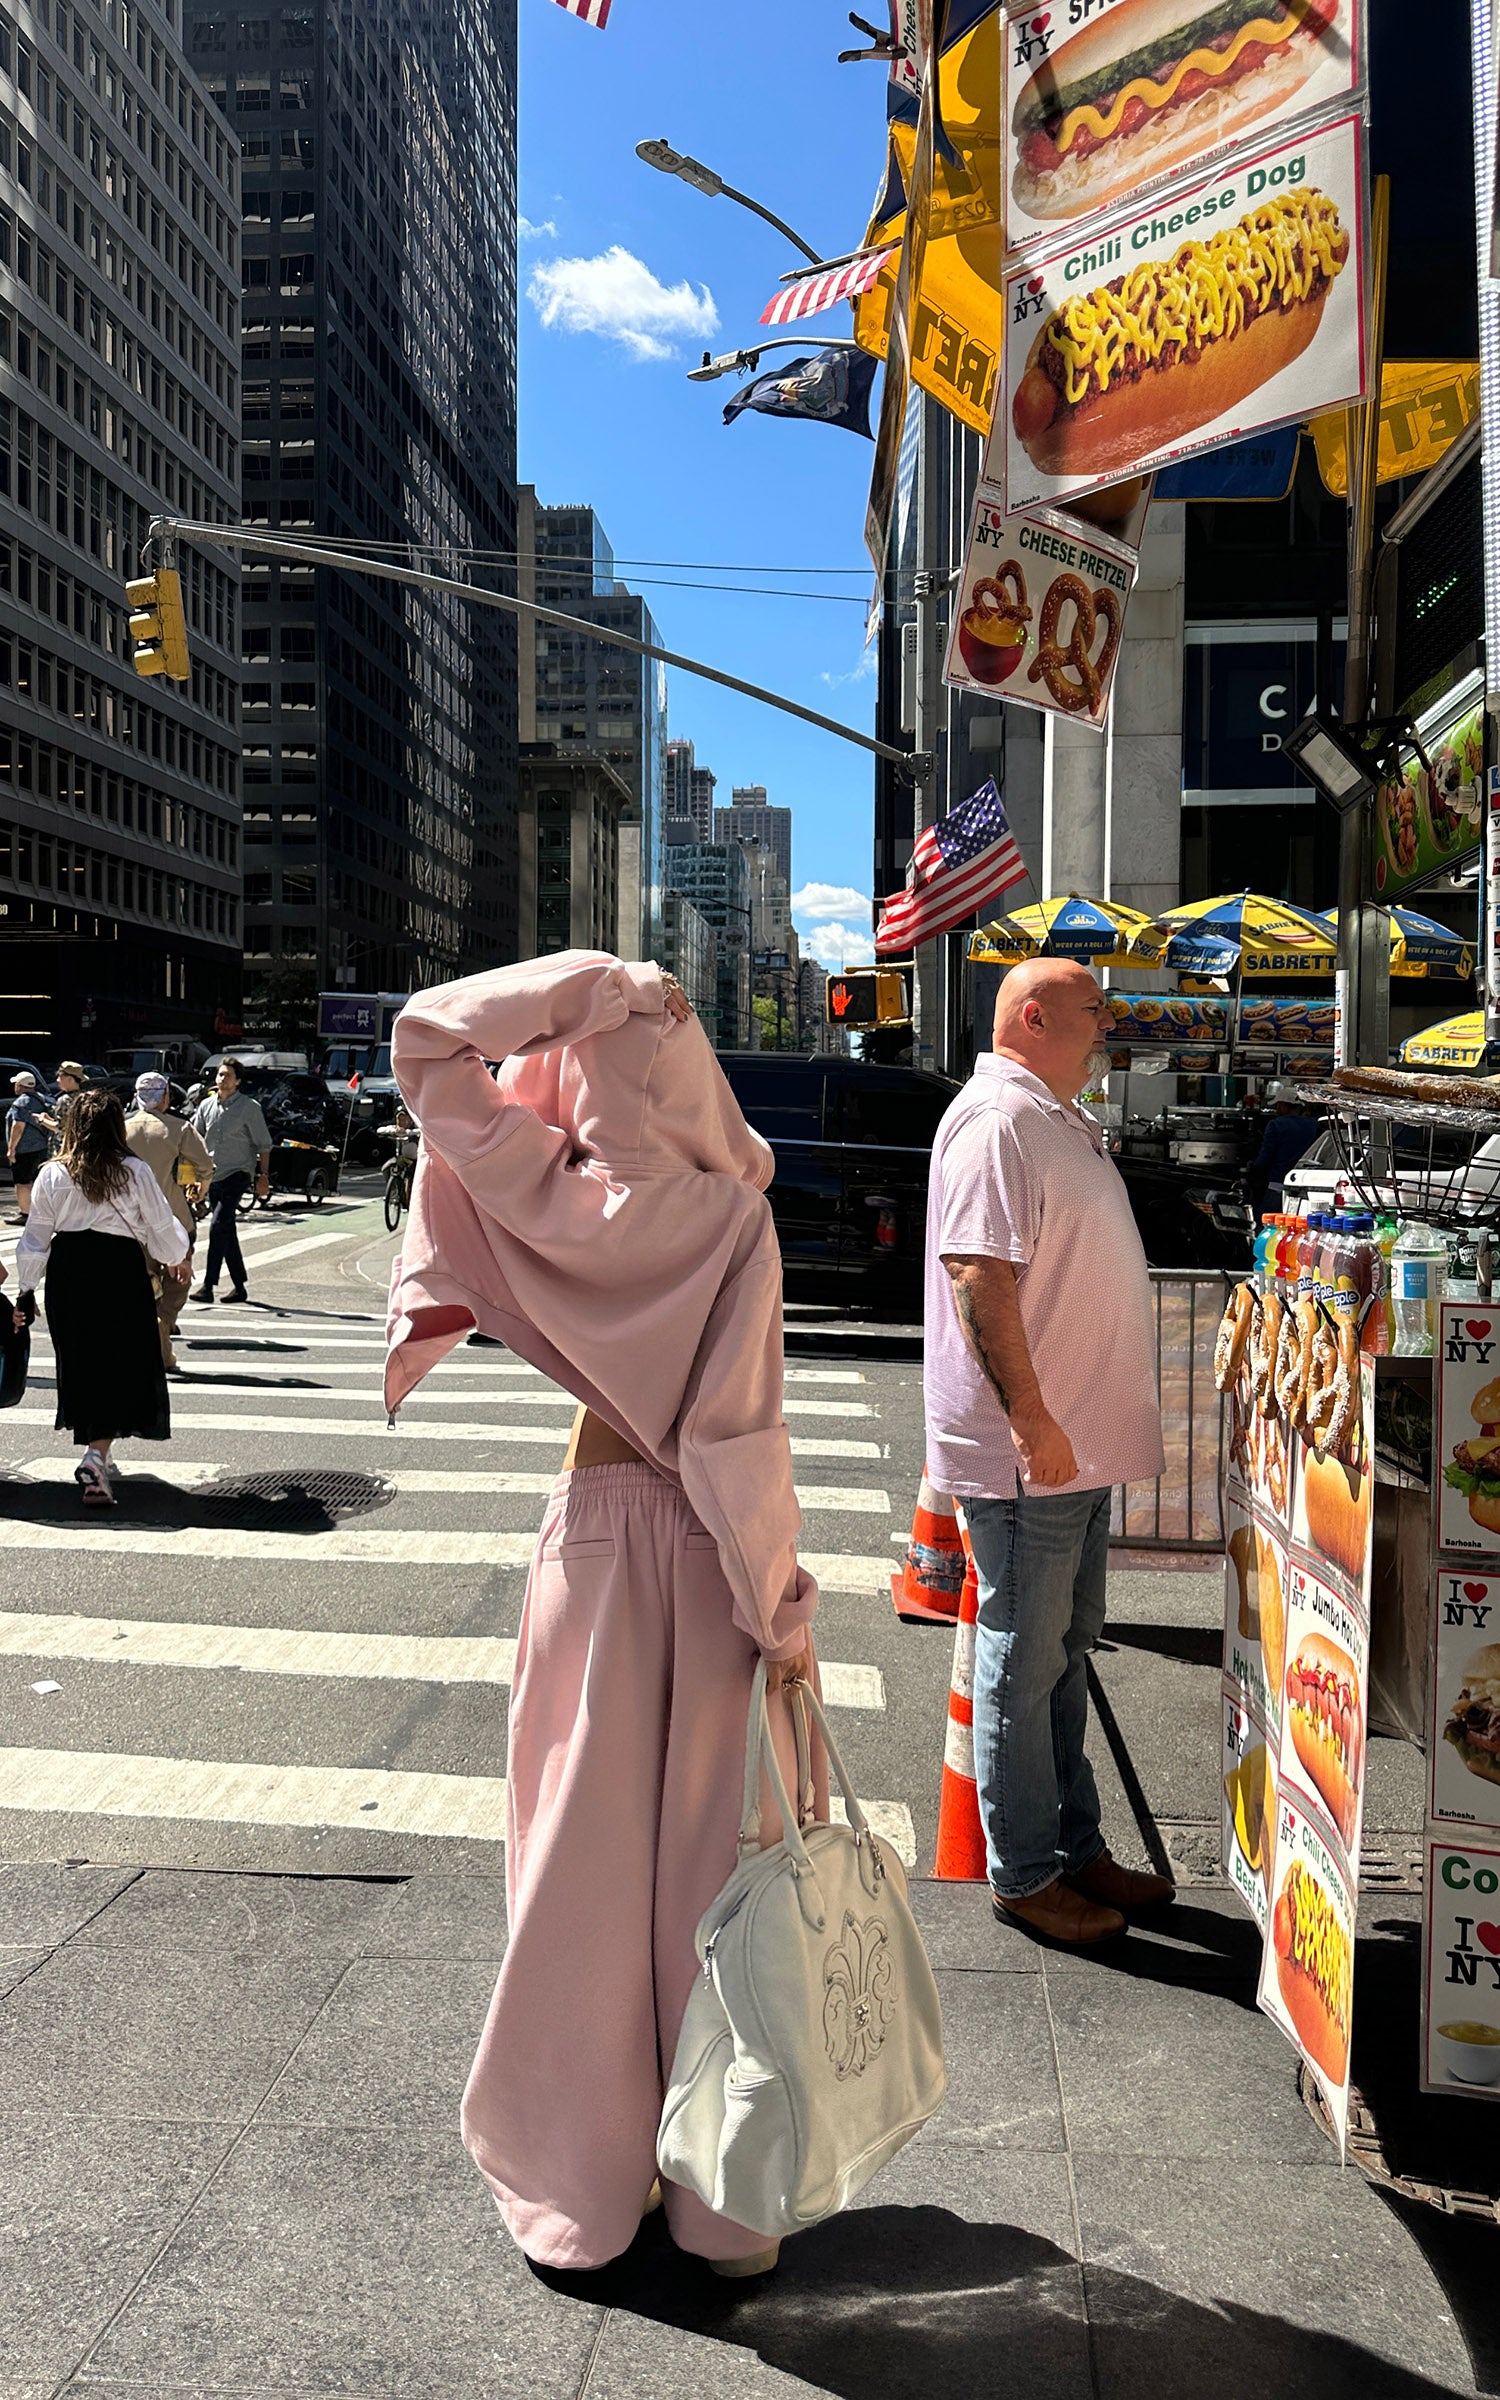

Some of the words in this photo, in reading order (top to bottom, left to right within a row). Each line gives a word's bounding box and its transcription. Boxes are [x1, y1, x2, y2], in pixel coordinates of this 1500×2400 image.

[1014, 29, 1055, 67] NY
[1063, 236, 1121, 282] Chili
[1131, 188, 1236, 250] Cheese
[1247, 154, 1307, 197] Dog
[1013, 291, 1048, 324] NY
[1135, 452, 1171, 470] PRINTING
[975, 524, 1004, 549] NY
[1018, 526, 1077, 567] CHEESE
[1079, 550, 1128, 591] PRETZEL
[1249, 921, 1303, 936] SABRETT
[978, 937, 1043, 952] SABRETT
[1246, 954, 1337, 970] SABRETT
[1409, 1047, 1480, 1061] SABRETT
[1450, 1318, 1464, 1340] I
[1445, 1340, 1496, 1364] NY
[1445, 1537, 1482, 1548] Barhosha
[1291, 1588, 1306, 1611] NY
[1449, 1579, 1463, 1603] I
[1312, 1586, 1340, 1632] Jumbo
[1443, 1602, 1492, 1629] NY
[1233, 1647, 1248, 1686] Hot
[1227, 1726, 1243, 1757] NY
[1438, 1808, 1476, 1821] Barhosha
[1280, 1823, 1296, 1850] NY
[1235, 1855, 1256, 1905] Beef
[1302, 1826, 1320, 1864] Chili
[1321, 1851, 1344, 1908] Cheese
[1454, 1916, 1475, 1952] I
